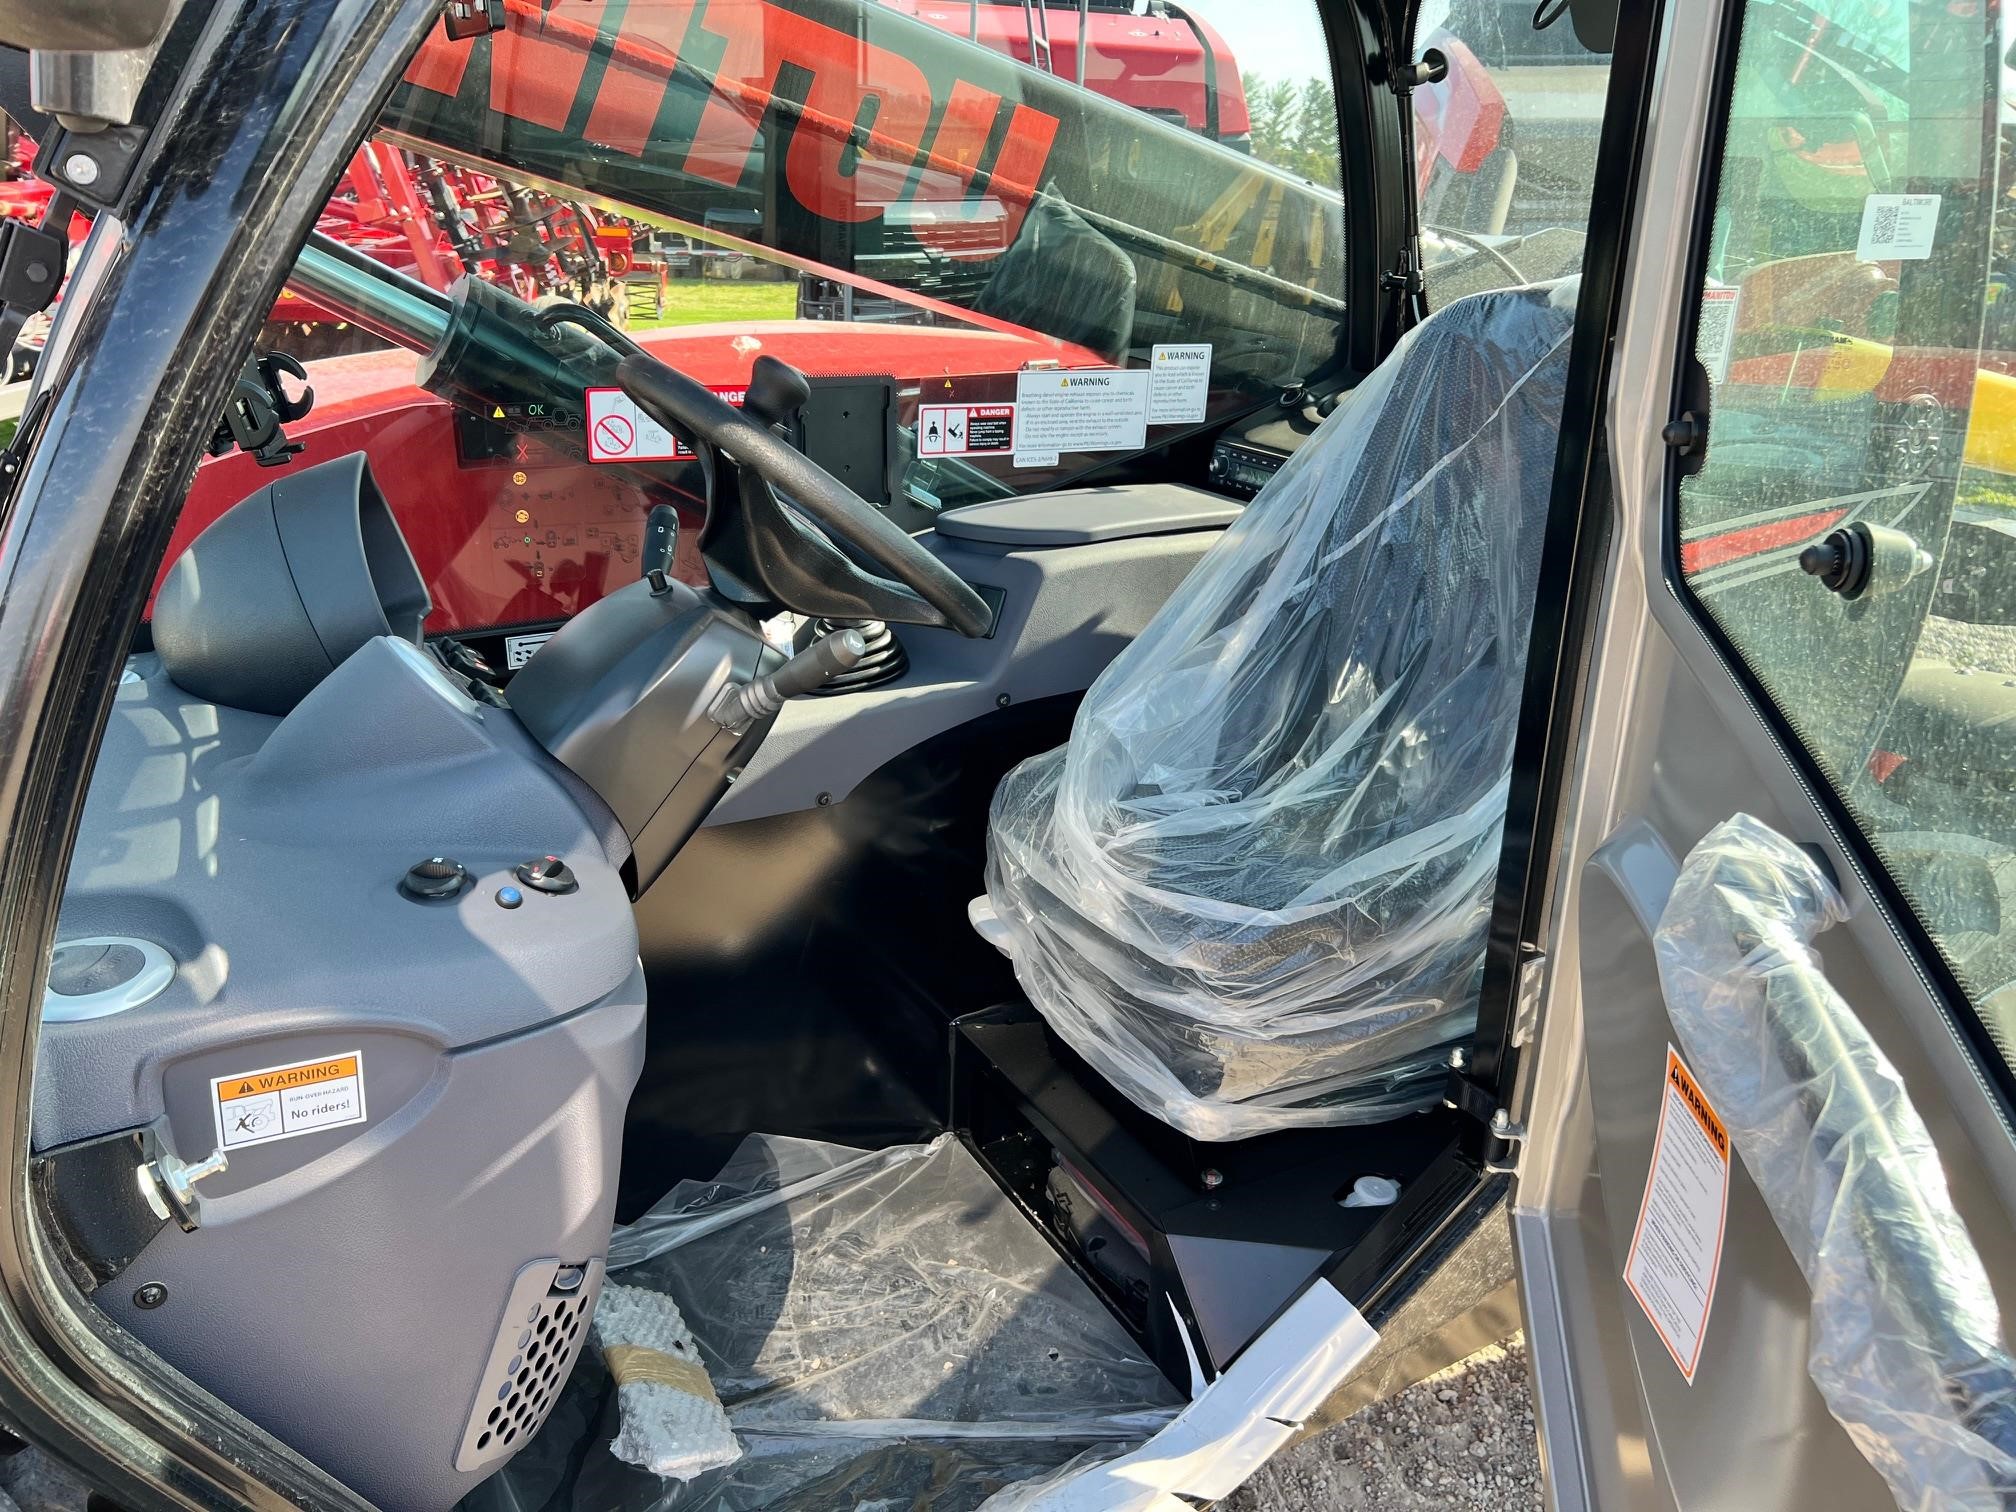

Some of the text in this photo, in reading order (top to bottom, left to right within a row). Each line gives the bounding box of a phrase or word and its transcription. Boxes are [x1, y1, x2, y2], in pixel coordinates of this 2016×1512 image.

[1168, 352, 1204, 360] WARNING
[1070, 378, 1110, 386] WARNING
[528, 404, 544, 415] OK
[259, 1064, 340, 1090] WARNING
[291, 1099, 350, 1120] No riders!
[1680, 1075, 1725, 1152] WARNING
